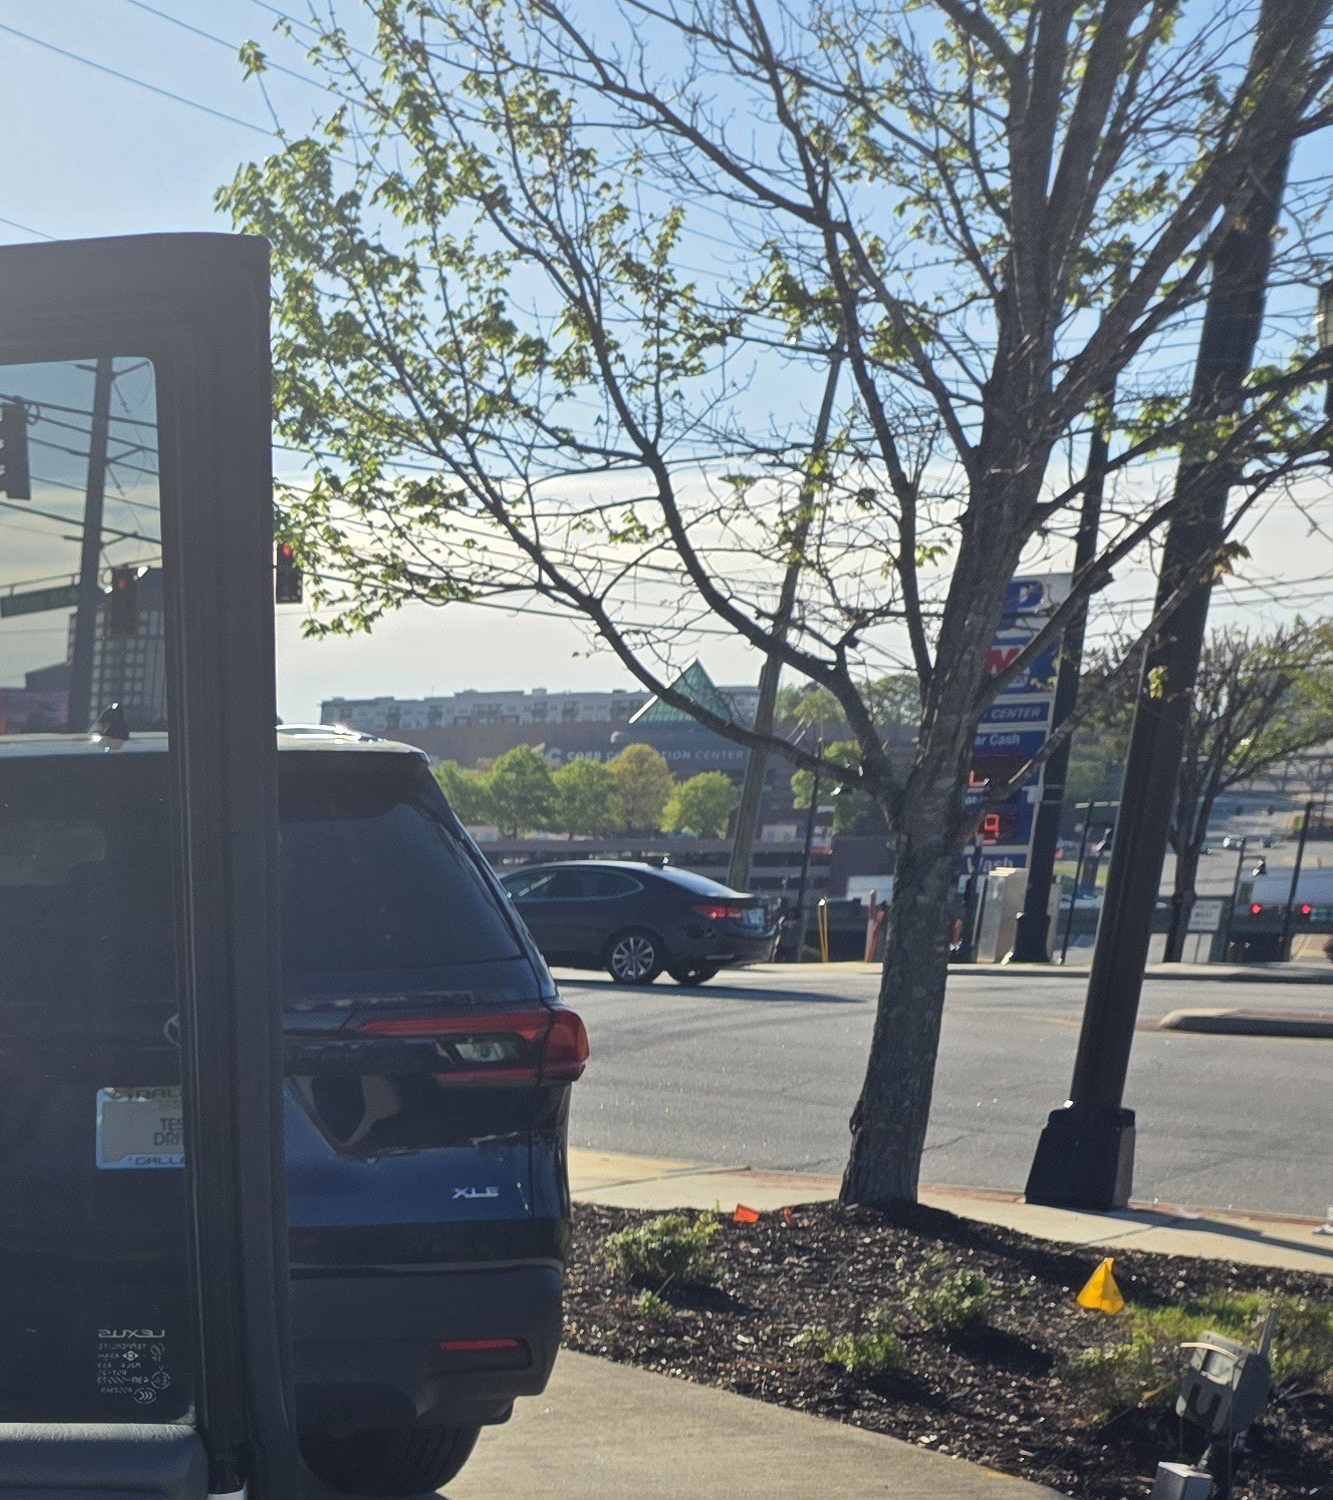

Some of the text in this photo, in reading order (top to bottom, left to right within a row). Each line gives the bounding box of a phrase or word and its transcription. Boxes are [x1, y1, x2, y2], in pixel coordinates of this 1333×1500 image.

[991, 707, 1041, 720] CENTER
[694, 750, 744, 761] CENTER
[452, 1186, 500, 1199] XLE
